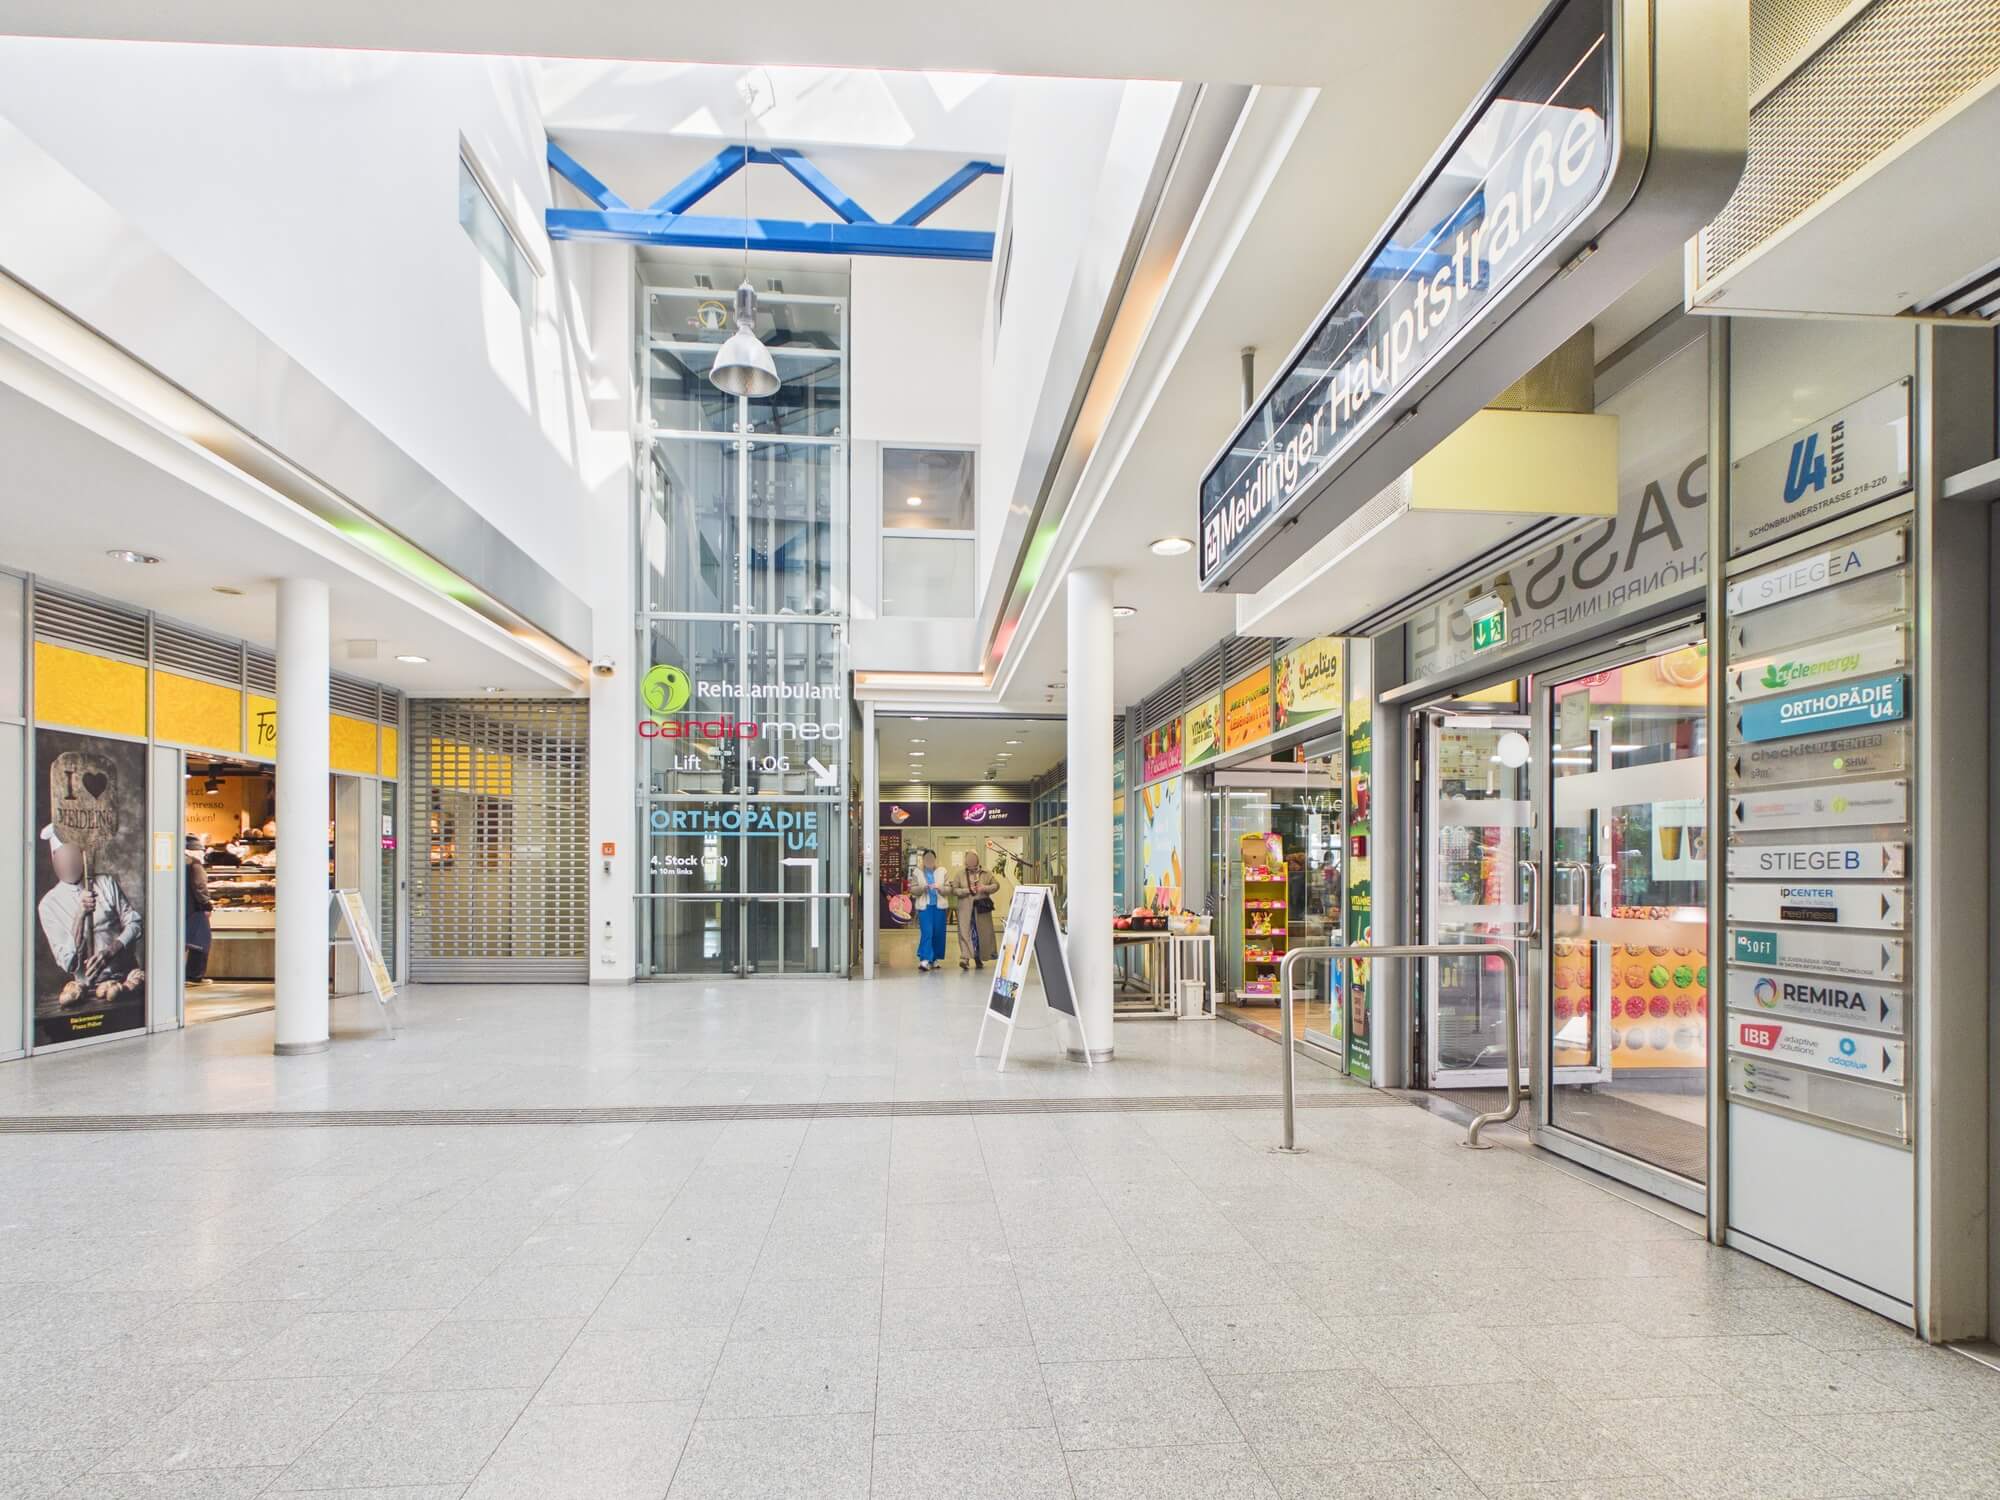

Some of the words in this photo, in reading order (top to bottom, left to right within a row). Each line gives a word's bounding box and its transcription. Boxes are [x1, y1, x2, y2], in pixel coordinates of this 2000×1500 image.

[1220, 400, 1324, 550] Meidlinger
[1330, 108, 1597, 435] Hauptstraße
[1831, 420, 1845, 485] CENTER
[1783, 431, 1828, 504] U4
[1748, 489, 1853, 538] SCHÖNBRUNNERSTRASSE
[1780, 684, 1893, 718] ORTHOPÄDIE
[1870, 703, 1893, 719] U4
[674, 755, 702, 770] Lift
[63, 770, 77, 800] I
[57, 807, 113, 830] MEIDLING
[650, 806, 817, 829] ORTHOPÄDIE
[787, 832, 818, 850] U4
[650, 856, 662, 866] 4.
[665, 855, 698, 866] Stock
[1747, 940, 1771, 954] SOFT
[1783, 983, 1867, 1011] REMIRA
[1744, 1028, 1770, 1045] IBB
[1783, 1035, 1819, 1049] adaptive
[1780, 1044, 1815, 1056] solutions
